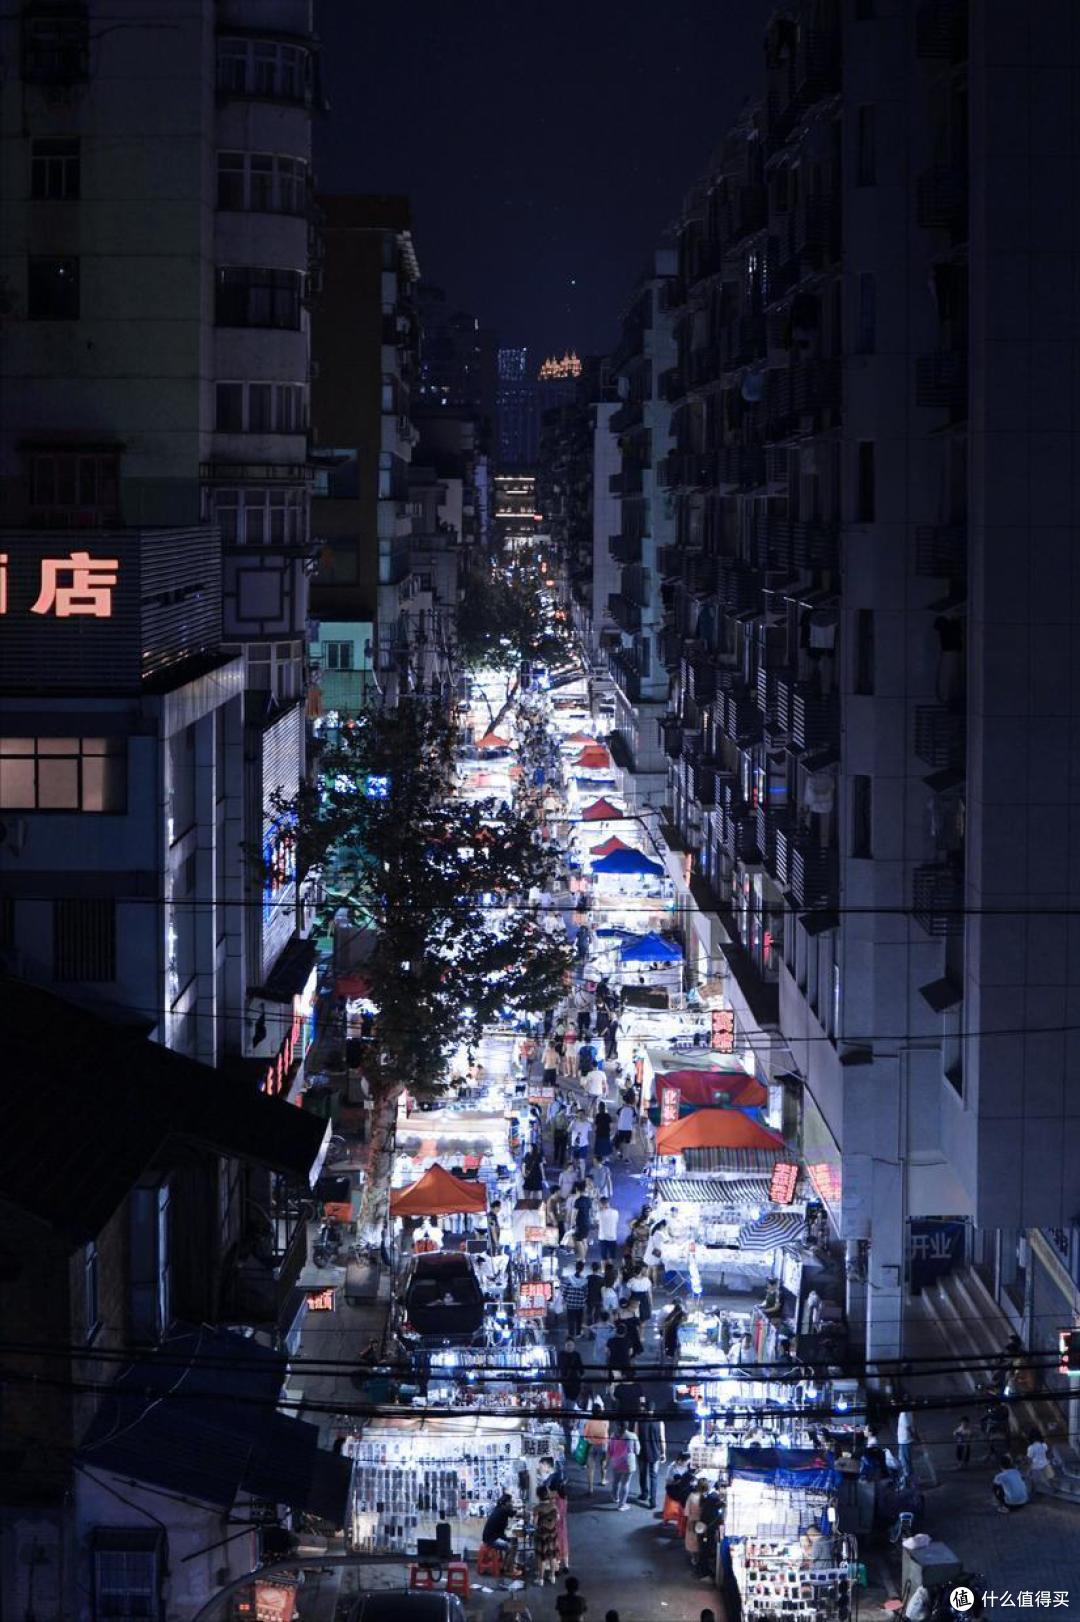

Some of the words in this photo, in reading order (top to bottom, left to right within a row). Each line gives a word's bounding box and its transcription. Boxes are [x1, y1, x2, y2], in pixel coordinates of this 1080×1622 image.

[0, 552, 119, 617] 店
[911, 1231, 952, 1260] 开业
[524, 1439, 550, 1455] 贴膜
